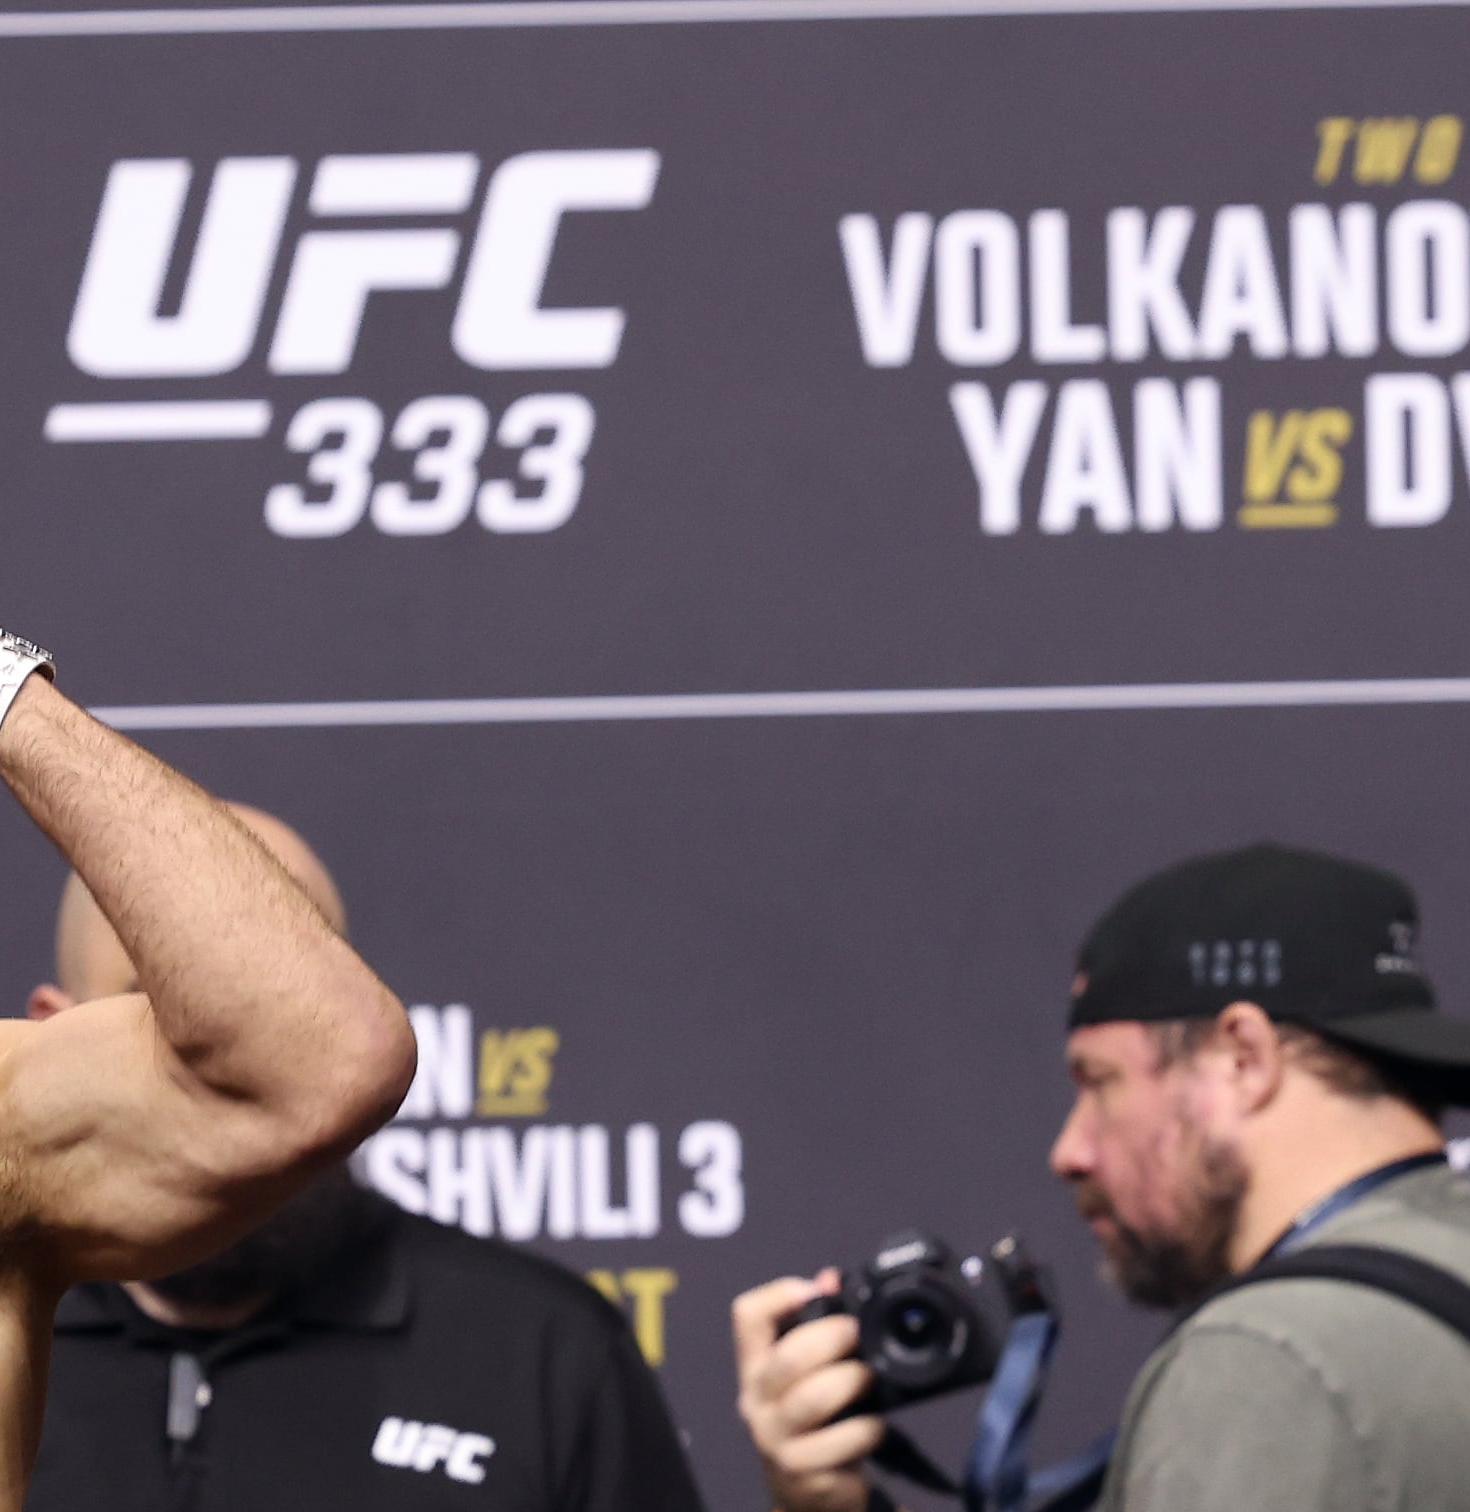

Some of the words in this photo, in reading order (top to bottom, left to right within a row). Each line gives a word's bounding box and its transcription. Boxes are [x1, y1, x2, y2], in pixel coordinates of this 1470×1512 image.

[1316, 114, 1463, 184] TWO
[67, 148, 660, 378] UFC
[264, 393, 594, 538] 333
[950, 376, 1223, 535] YAN
[679, 1121, 743, 1236] 3
[371, 1417, 495, 1484] UFC
